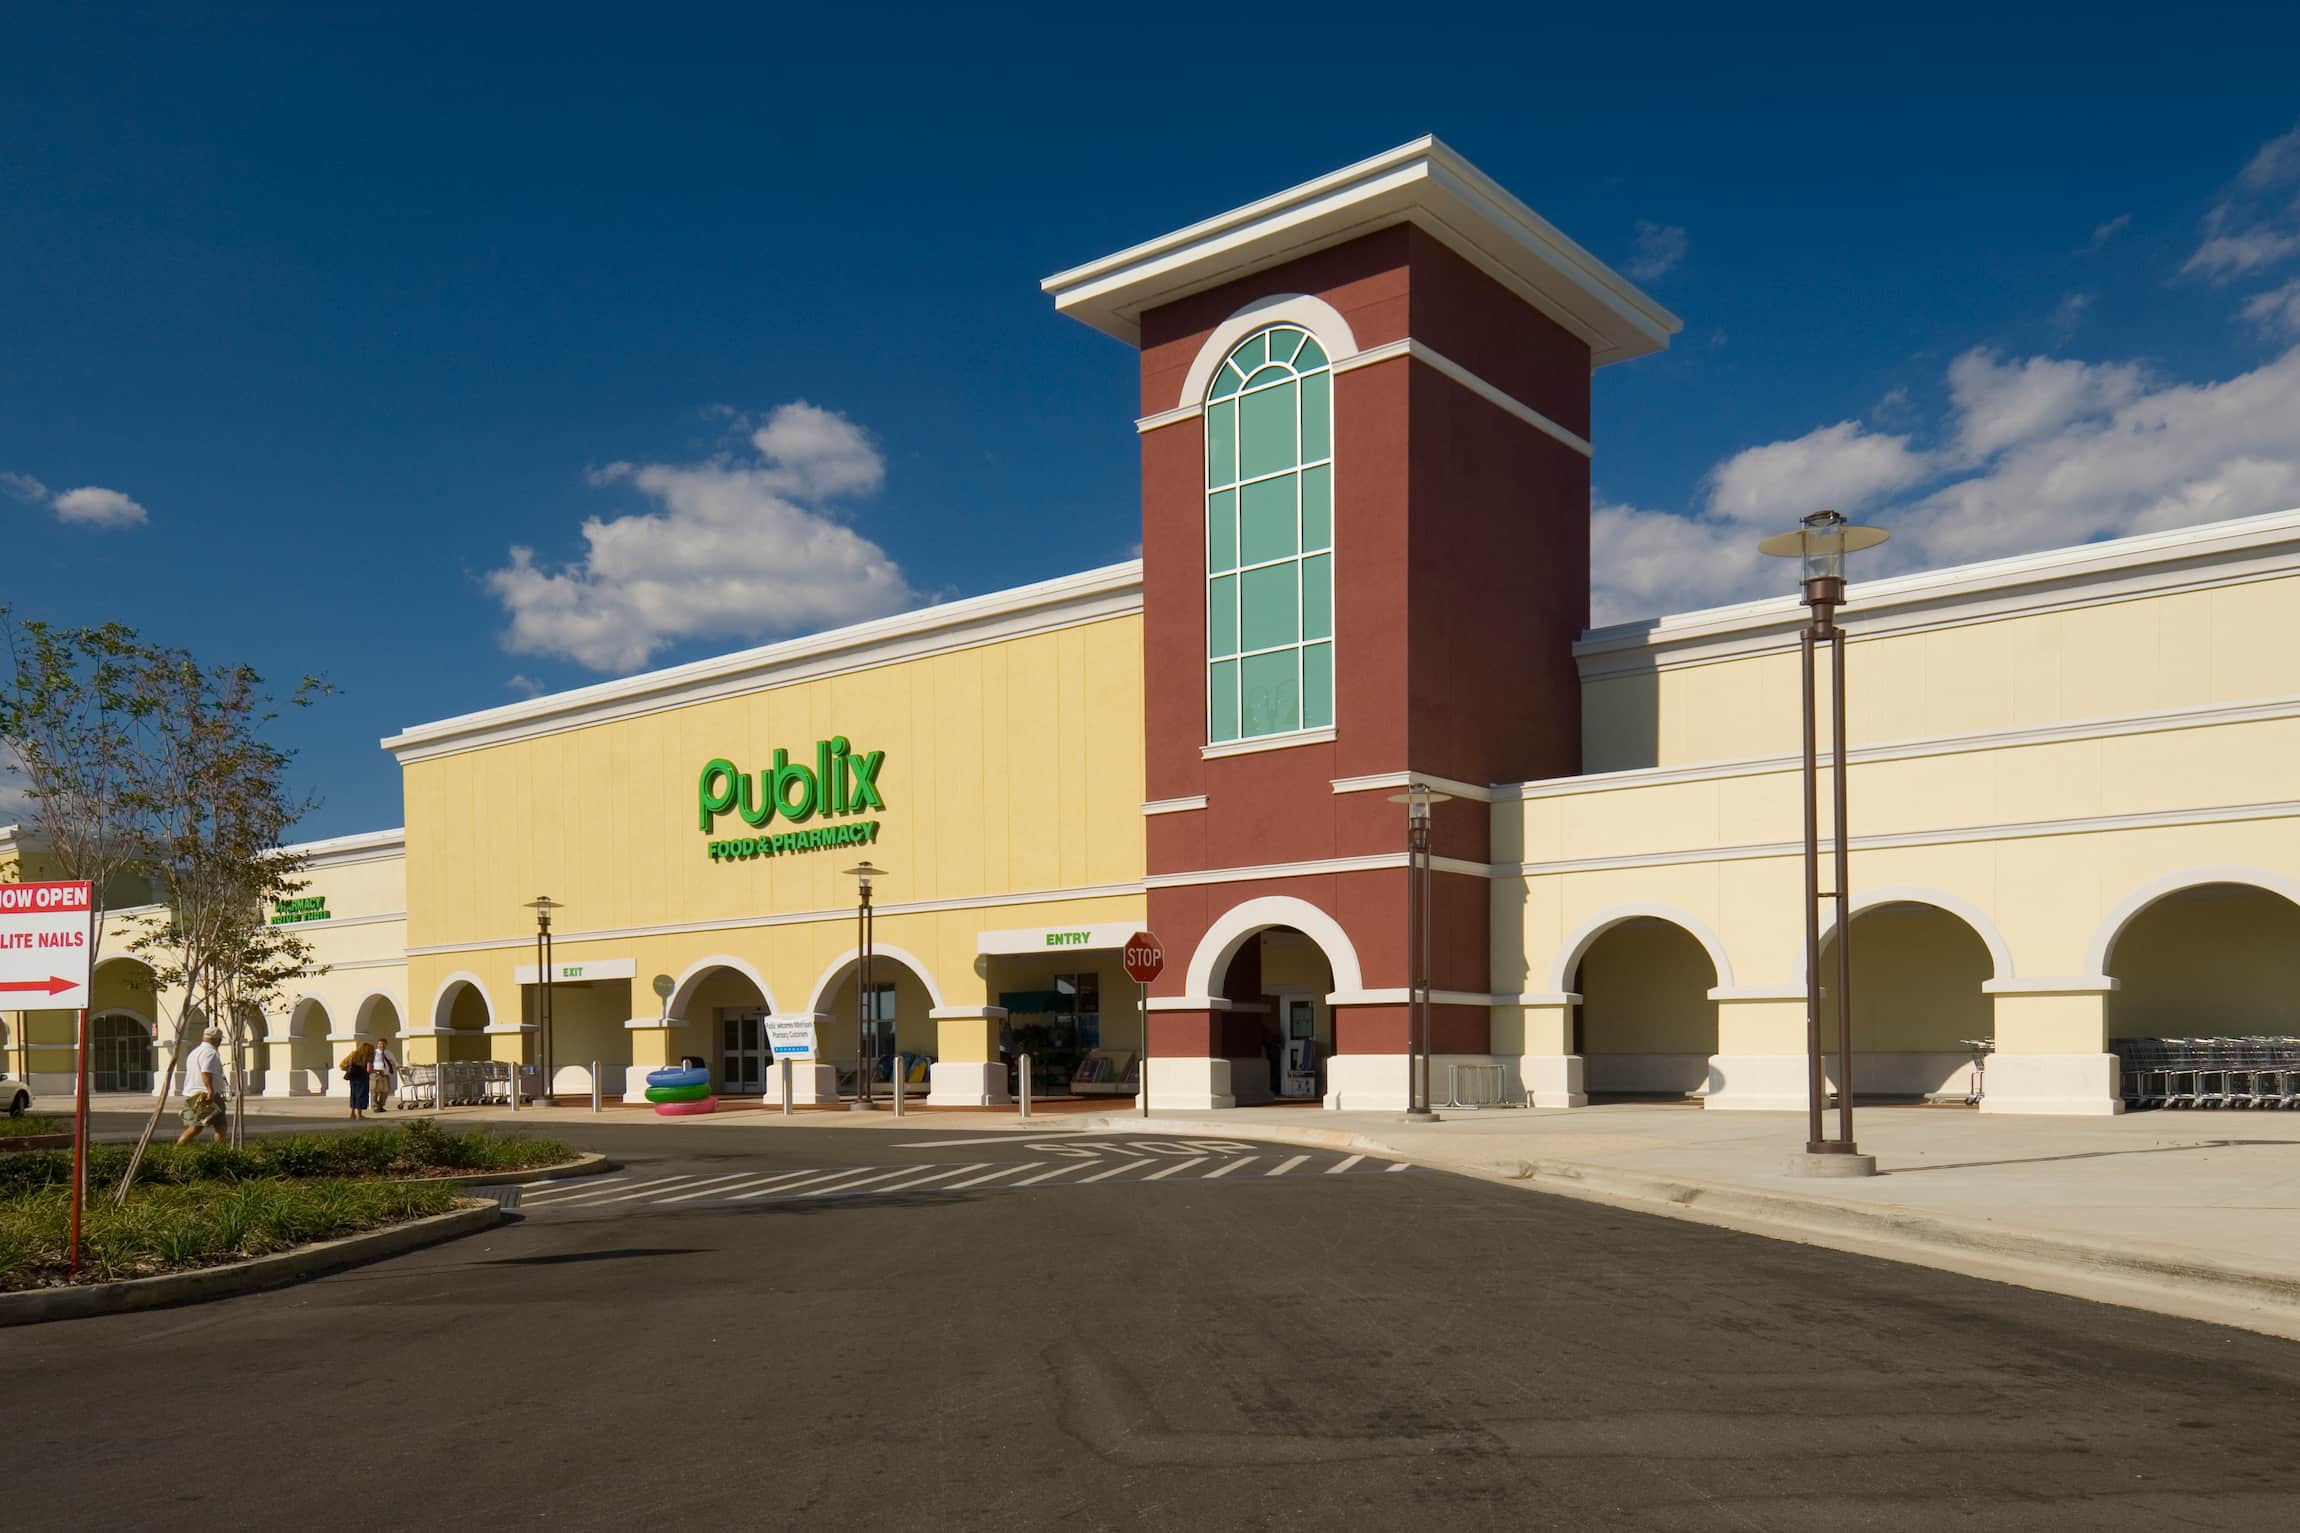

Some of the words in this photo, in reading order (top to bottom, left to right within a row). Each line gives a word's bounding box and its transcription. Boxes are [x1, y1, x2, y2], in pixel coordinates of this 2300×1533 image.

[707, 838, 754, 859] FOOD
[757, 836, 771, 853] &
[772, 821, 879, 851] PHARMACY
[0, 889, 33, 908] OW
[36, 887, 87, 907] OPEN
[0, 933, 33, 949] LITE
[39, 931, 84, 948] NAILS
[1046, 931, 1091, 945] ENTRY
[1127, 948, 1161, 967] STOP
[562, 967, 583, 977] EXIT
